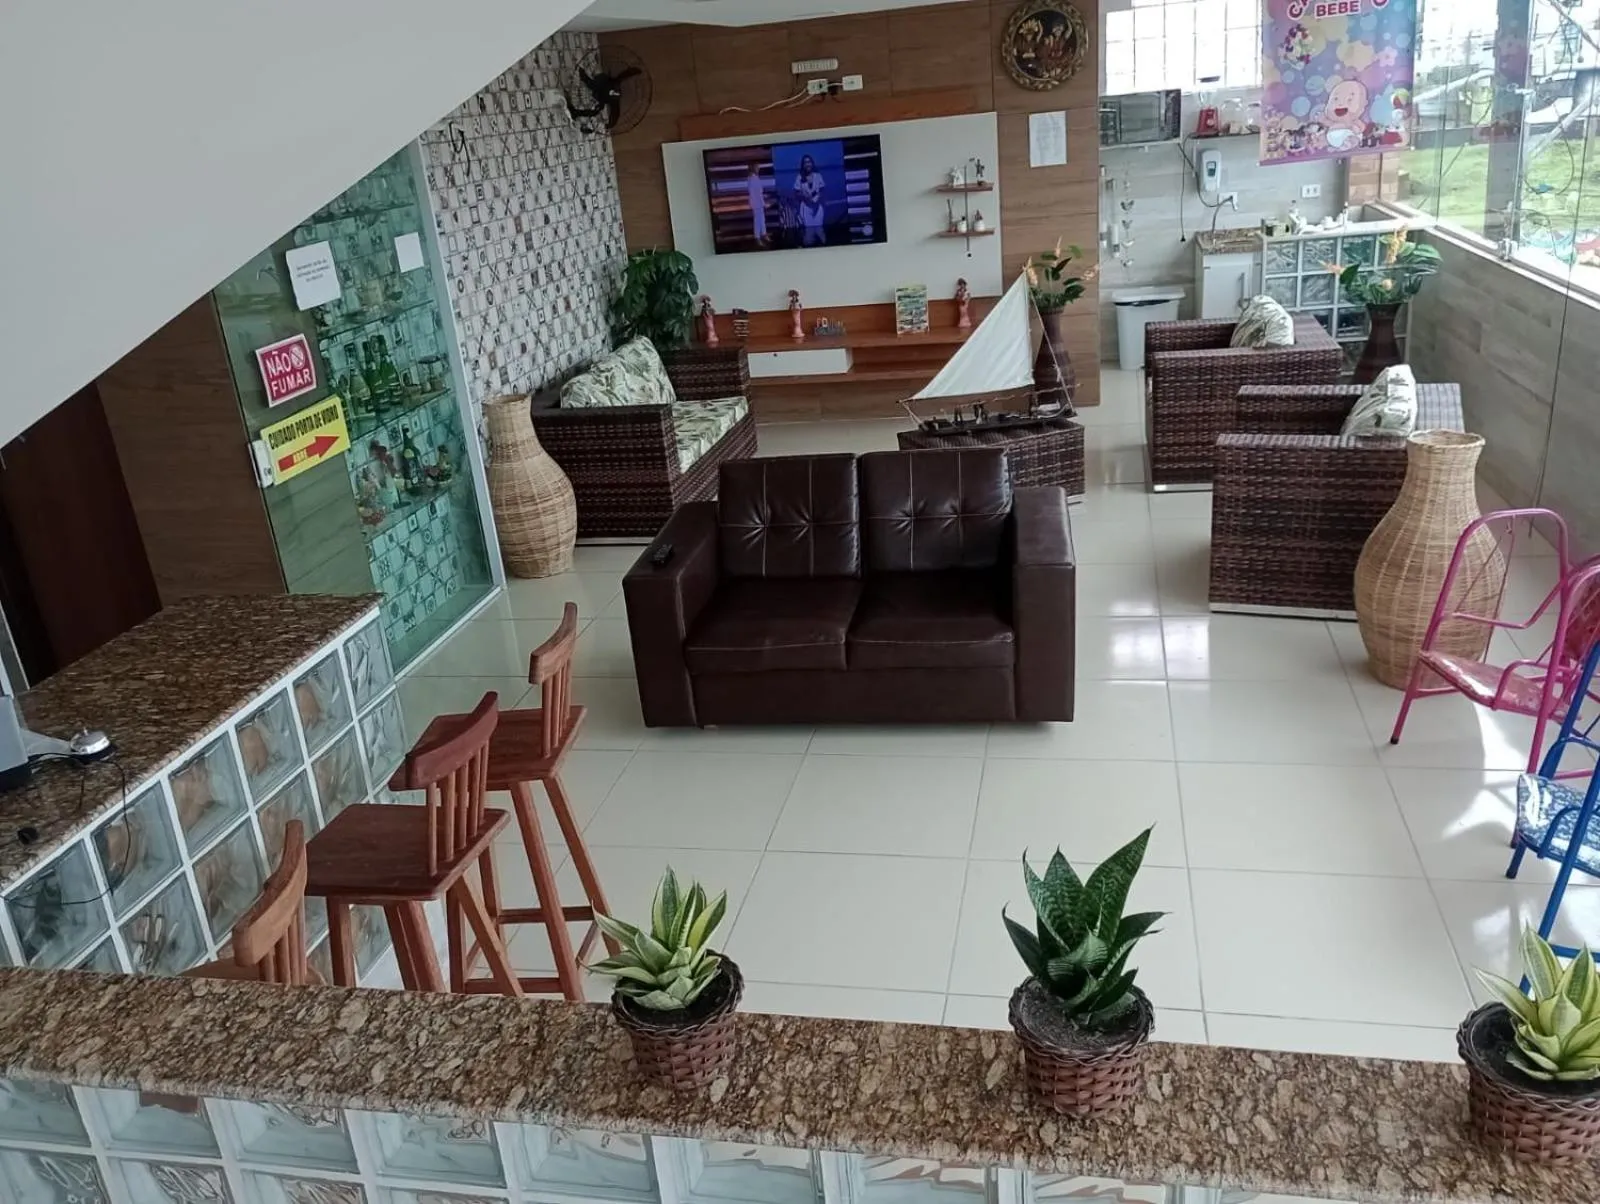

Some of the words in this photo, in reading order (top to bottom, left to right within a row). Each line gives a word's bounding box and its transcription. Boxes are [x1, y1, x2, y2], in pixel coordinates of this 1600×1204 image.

[265, 350, 292, 379] NÃO
[271, 368, 312, 398] FUMAR
[268, 422, 297, 450] CUIDADO
[295, 415, 315, 436] PORTA
[313, 411, 323, 429] DE
[321, 404, 339, 424] VIDRO
